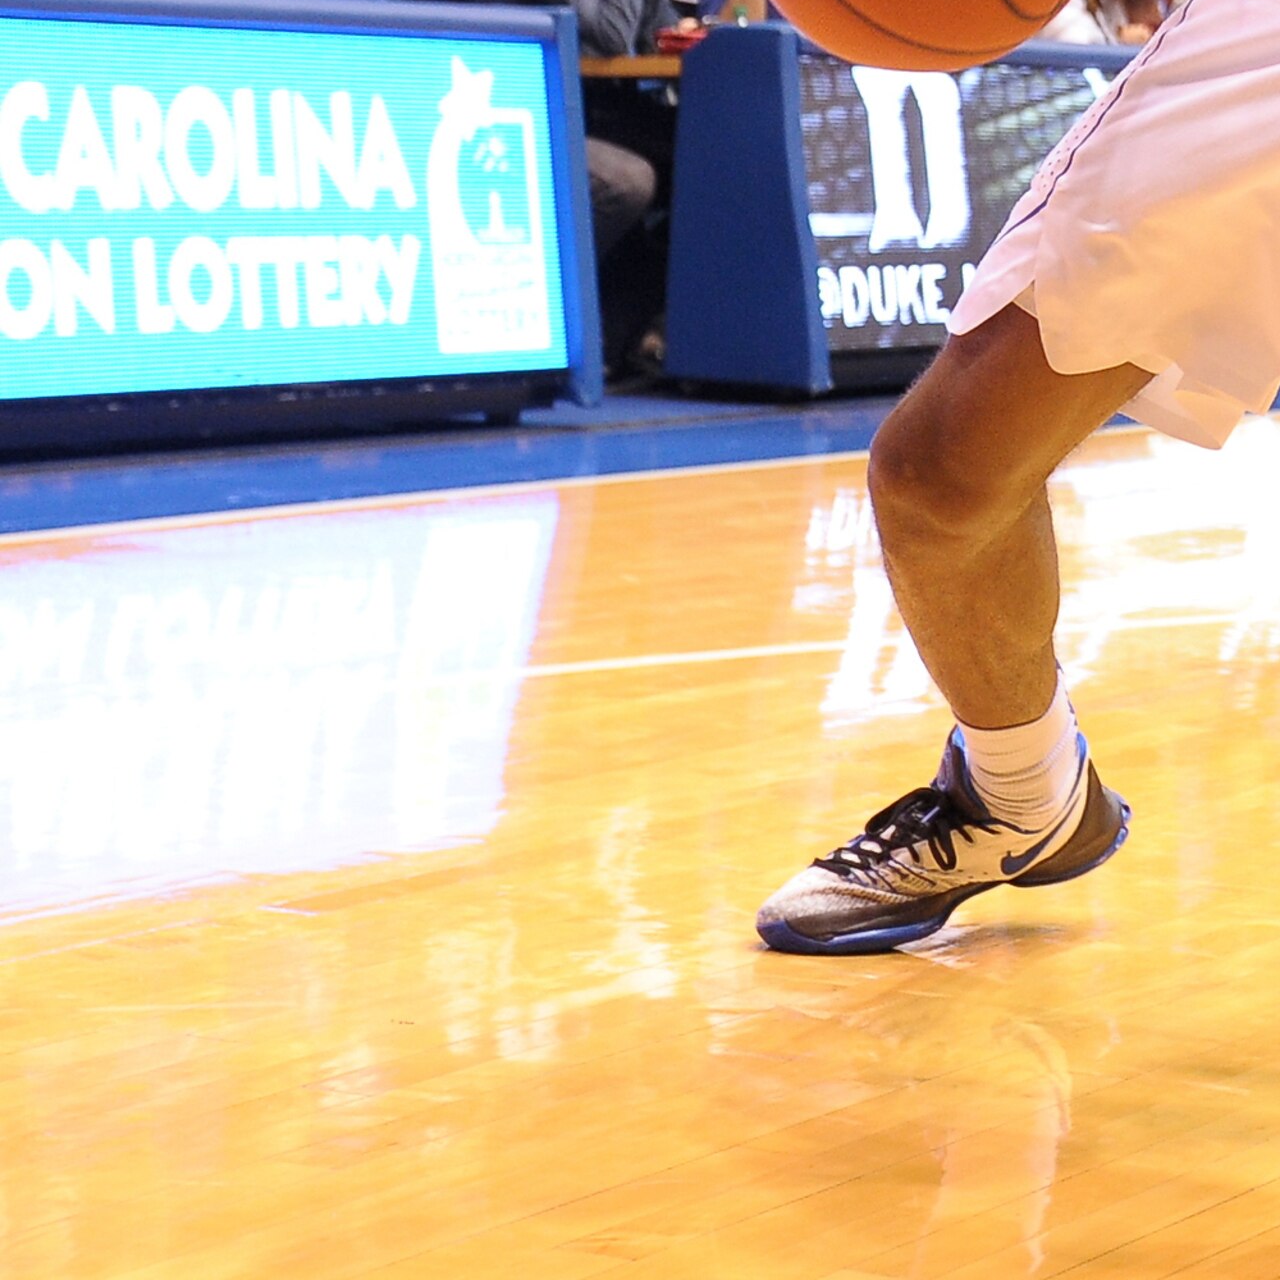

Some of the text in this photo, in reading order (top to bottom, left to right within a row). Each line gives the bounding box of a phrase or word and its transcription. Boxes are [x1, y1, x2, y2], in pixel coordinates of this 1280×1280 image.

[0, 81, 418, 213] CAROLINA
[0, 236, 115, 340] ON
[132, 234, 422, 336] LOTTERY
